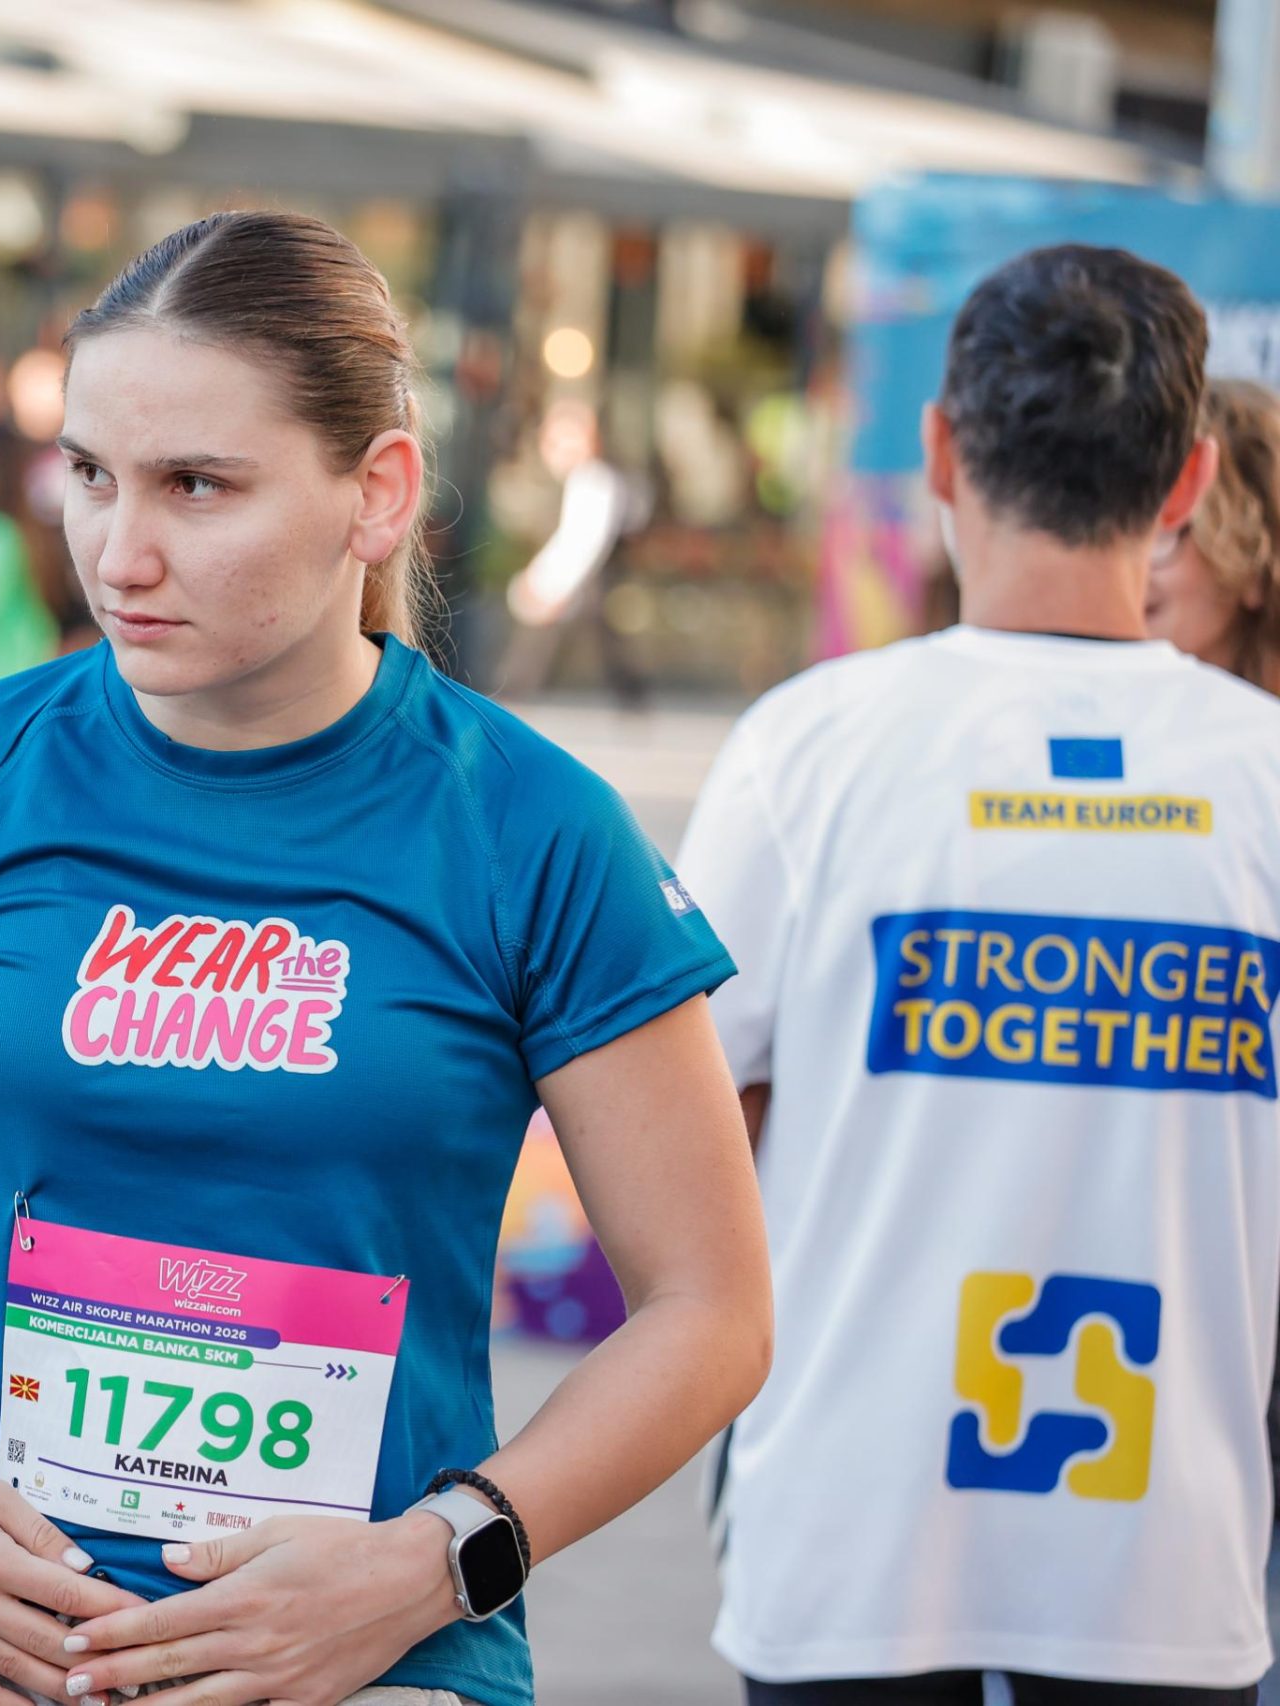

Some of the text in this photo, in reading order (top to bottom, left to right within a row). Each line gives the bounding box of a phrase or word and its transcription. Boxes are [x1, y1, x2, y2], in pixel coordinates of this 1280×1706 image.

[982, 798, 1200, 829] TEAM EUROPE
[84, 911, 291, 994] WEAR
[898, 929, 1271, 1013] STRONGER
[70, 985, 333, 1065] CHANGE
[893, 998, 1267, 1081] TOGETHER
[31, 1292, 247, 1341] WIZZ AIR SKOPJE MARATHON 2026
[173, 1298, 242, 1317] wizzair.com
[28, 1315, 239, 1364] KOMERCIJALNA BANKA 5KM
[65, 1367, 313, 1470] 11798
[114, 1453, 229, 1487] KATERINA
[161, 1510, 196, 1522] Heineken
